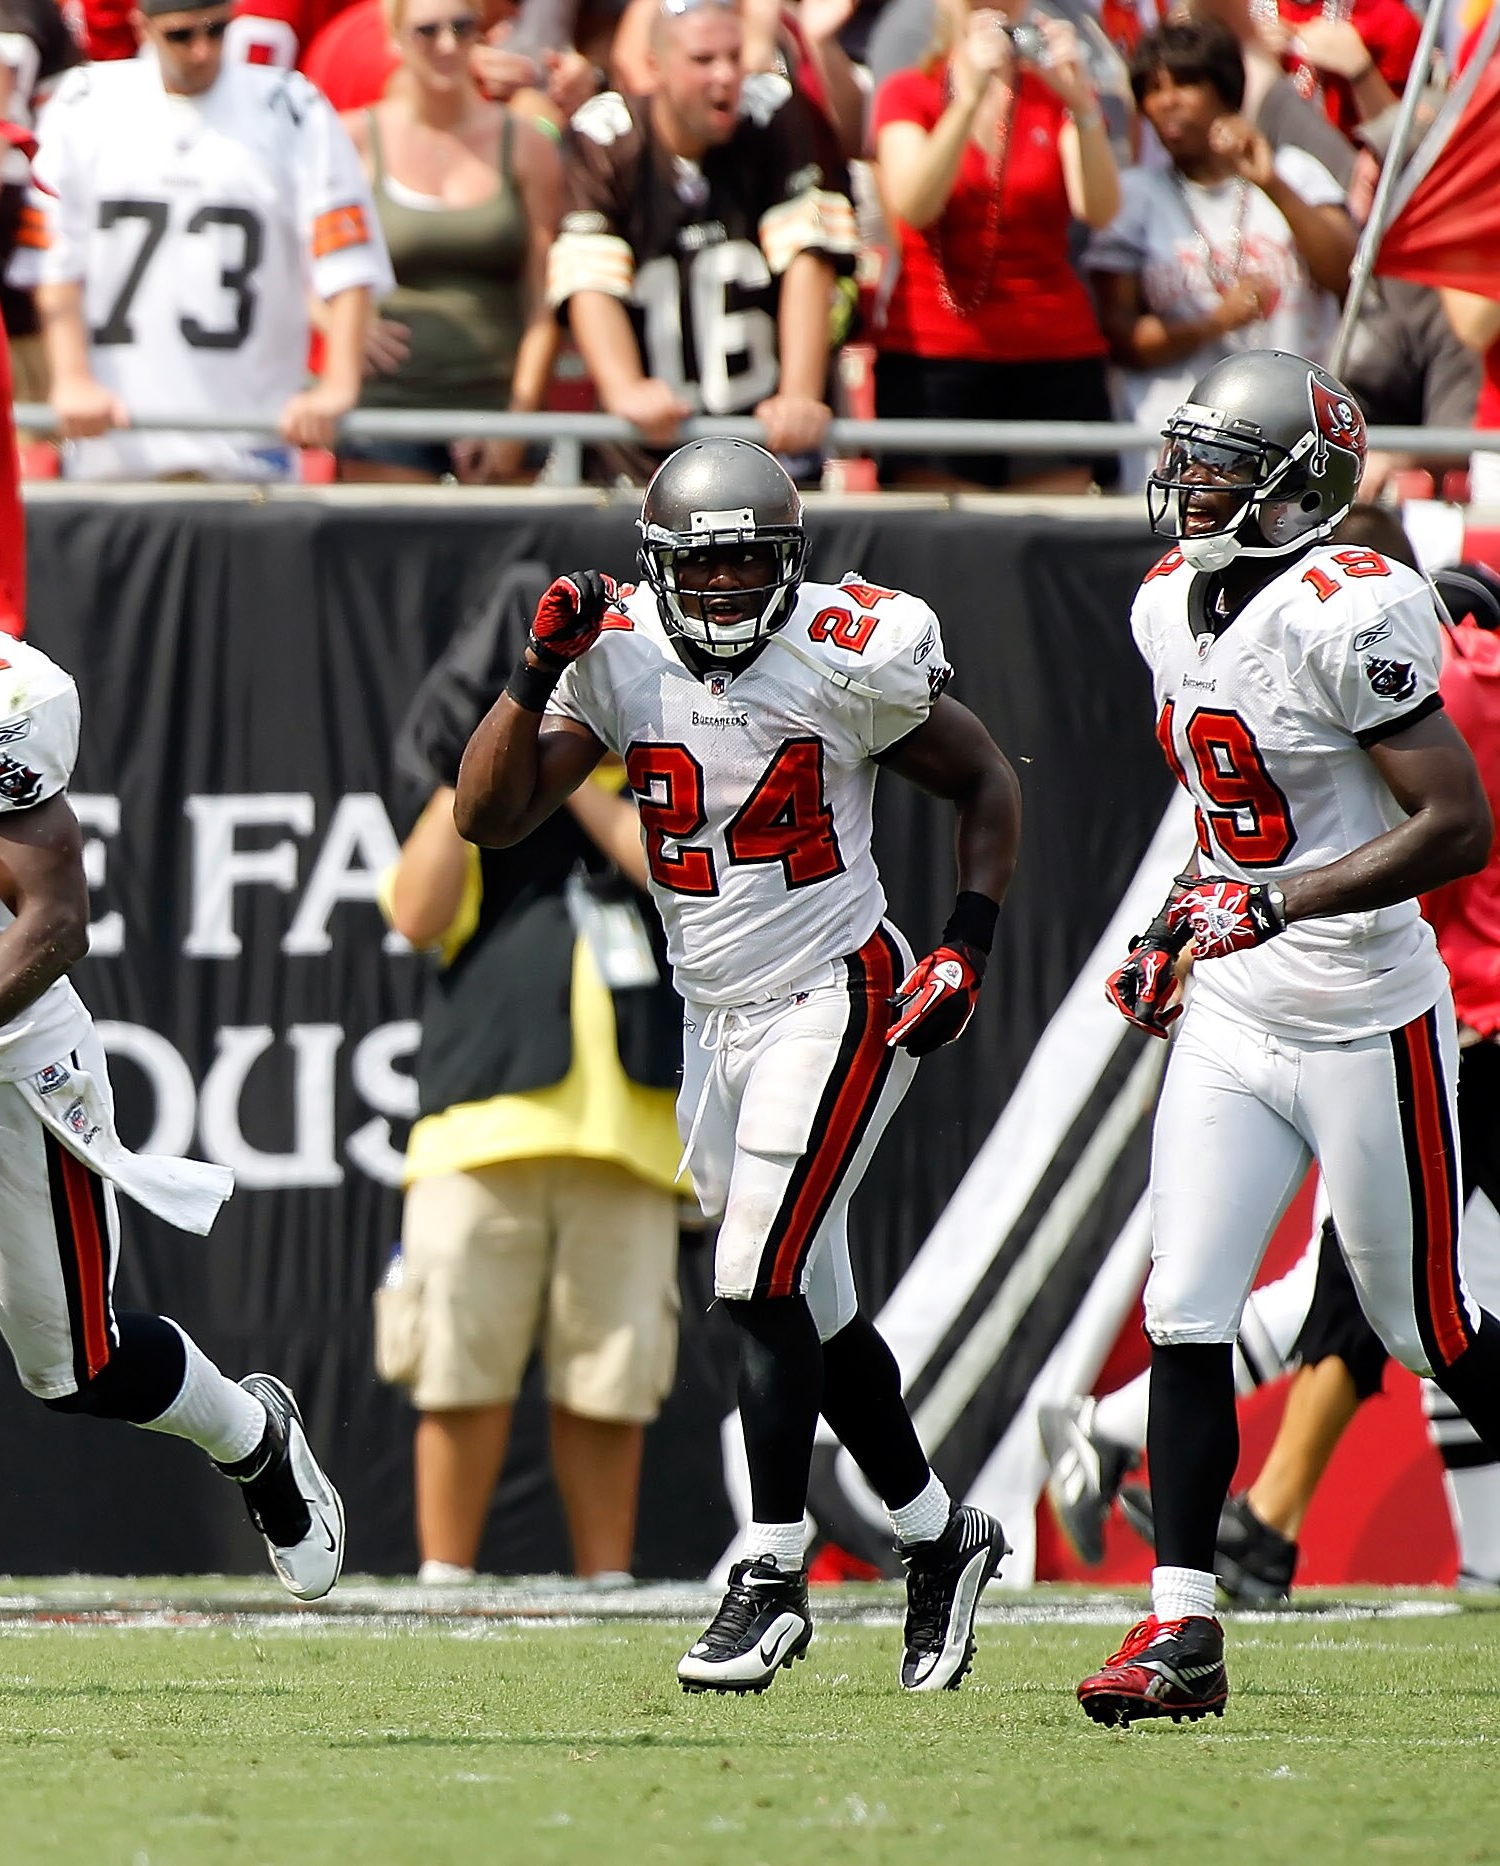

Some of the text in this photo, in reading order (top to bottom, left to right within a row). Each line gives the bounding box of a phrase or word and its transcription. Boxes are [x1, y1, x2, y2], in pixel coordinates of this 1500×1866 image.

[93, 200, 263, 348] 73
[630, 238, 779, 415] 16
[1301, 550, 1392, 603] 19
[624, 736, 848, 898] 24
[1156, 698, 1299, 867] 19
